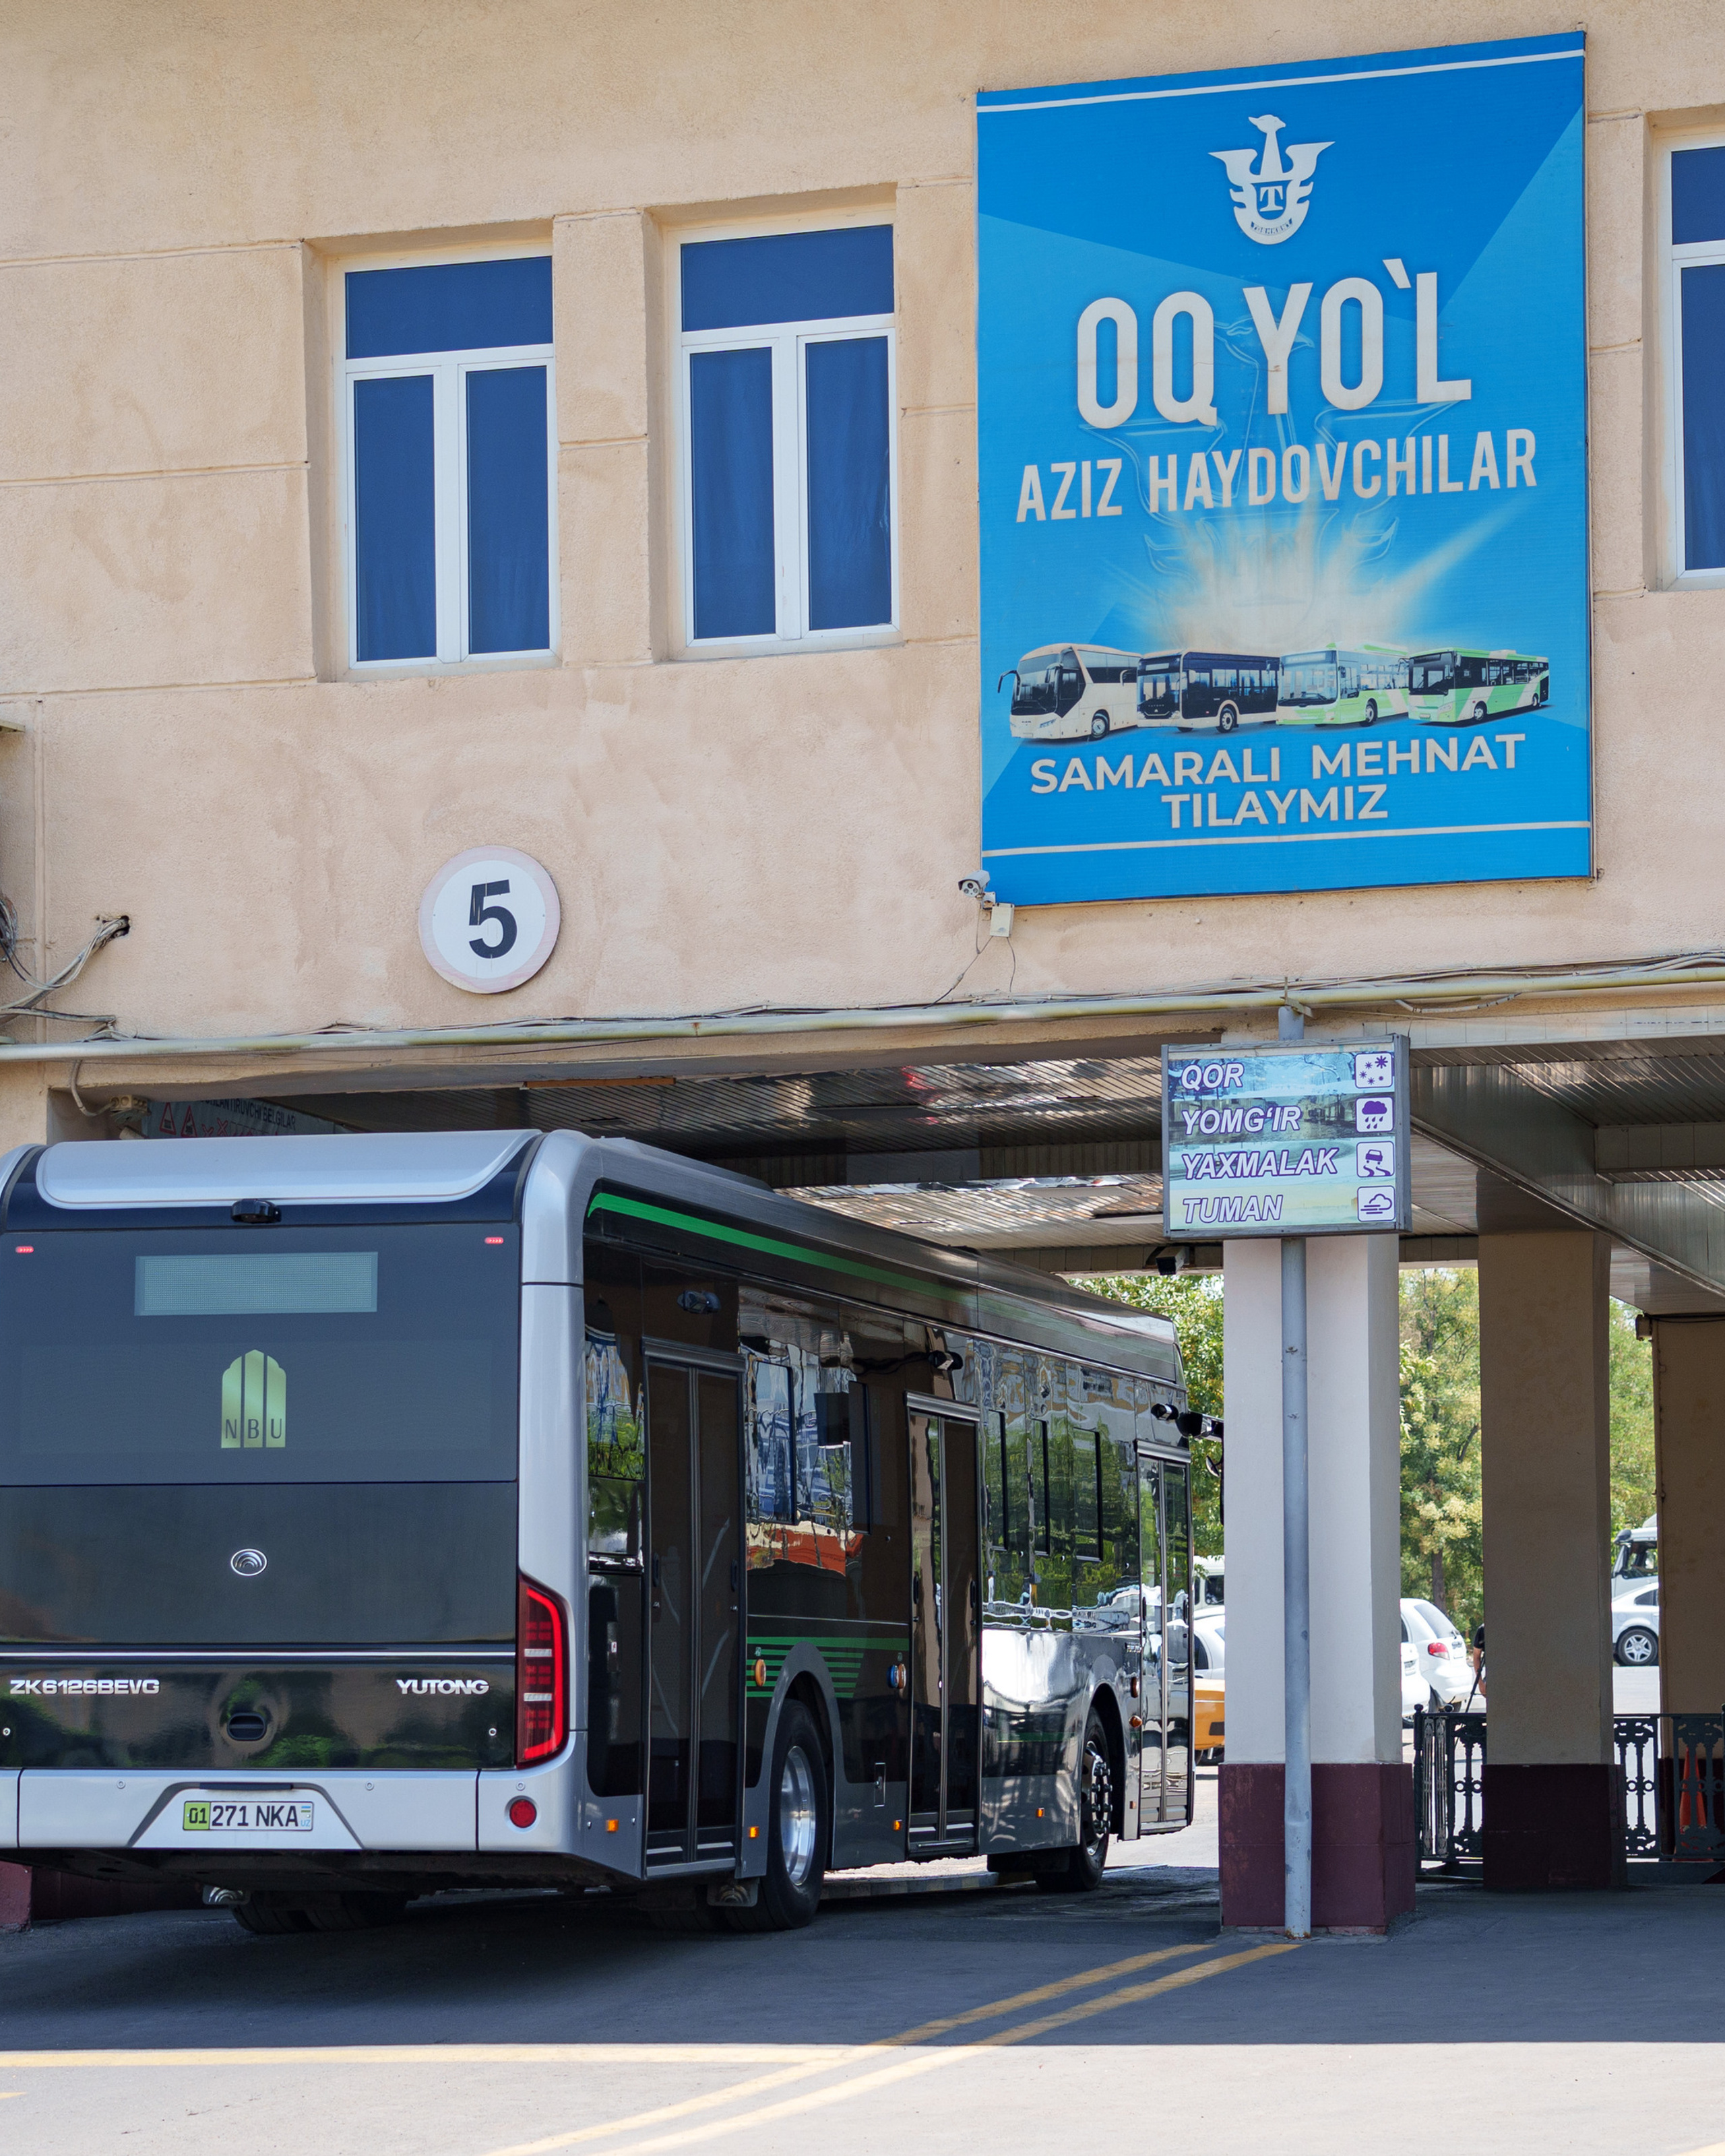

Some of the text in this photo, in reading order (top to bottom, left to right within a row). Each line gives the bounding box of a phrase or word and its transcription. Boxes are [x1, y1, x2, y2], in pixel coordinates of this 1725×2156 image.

[1077, 291, 1218, 429] OQ
[1016, 429, 1537, 523] AZIZ HAYDOVCHILAR
[1030, 733, 1526, 794] SAMARALI MEHNAT
[1161, 784, 1389, 829] TILAYMIZ
[468, 879, 518, 959] 5
[1181, 1063, 1245, 1091] QOR
[1181, 1147, 1340, 1180] YAXMALAK
[1183, 1195, 1284, 1224] TUMAN
[225, 1418, 282, 1439] NBU
[9, 1679, 160, 1694] ZK6126BEVG
[396, 1679, 490, 1694] YUTONG
[189, 1805, 311, 1827] 01 271 NKA UZ
